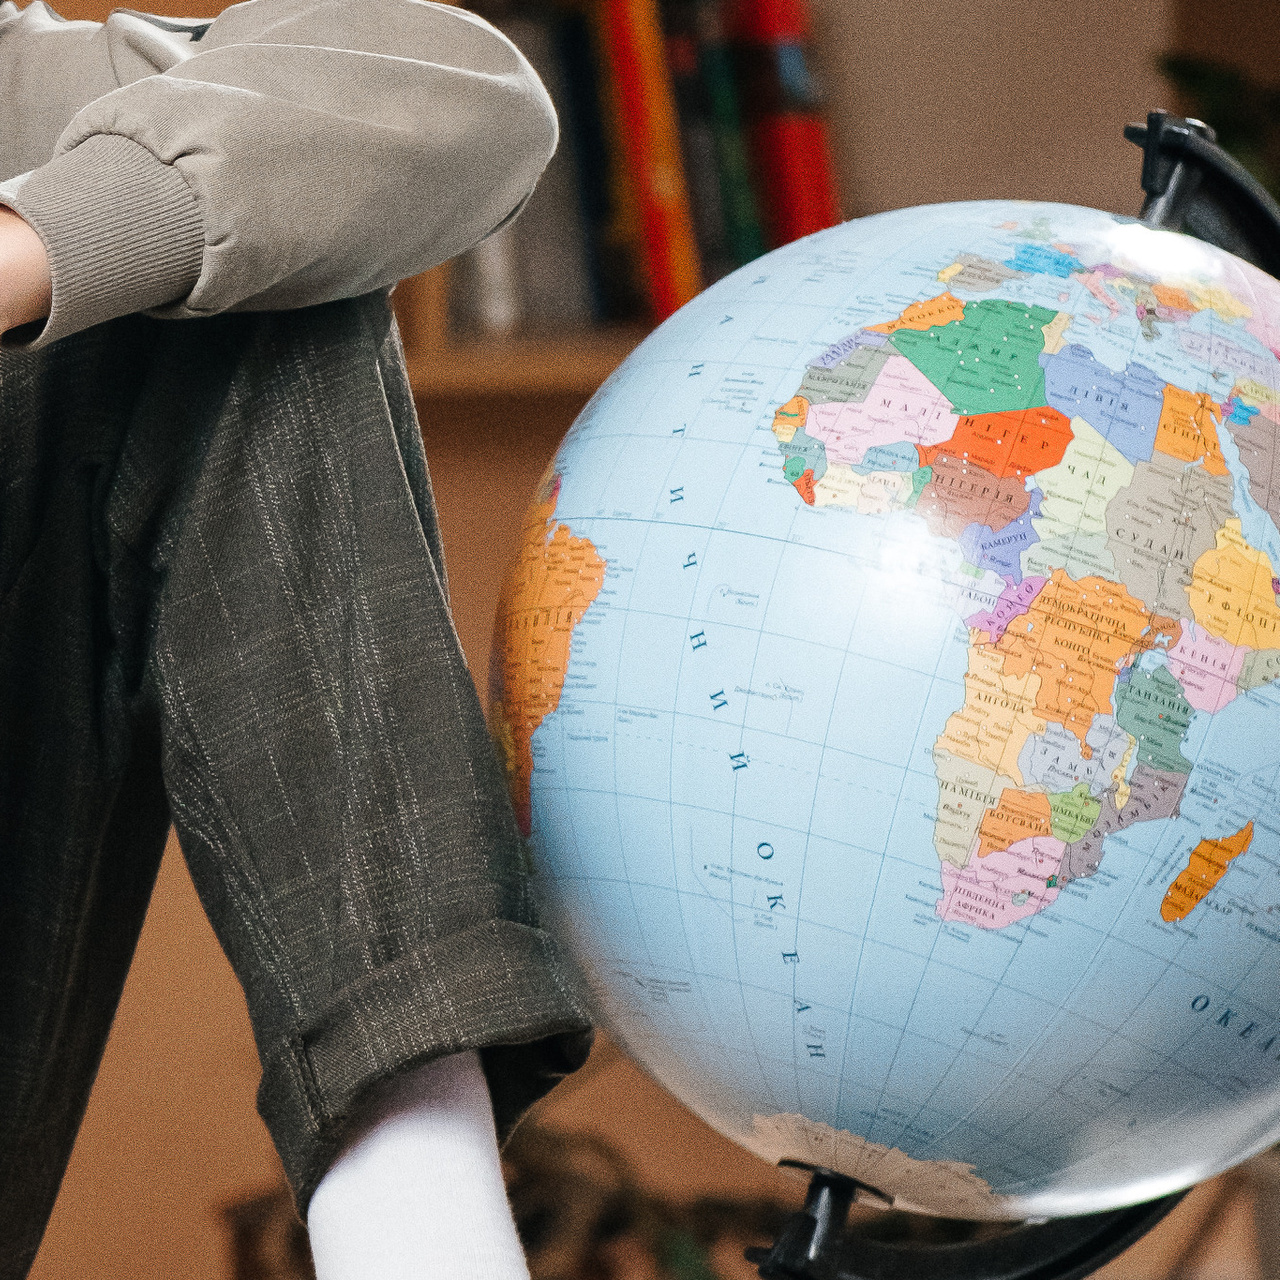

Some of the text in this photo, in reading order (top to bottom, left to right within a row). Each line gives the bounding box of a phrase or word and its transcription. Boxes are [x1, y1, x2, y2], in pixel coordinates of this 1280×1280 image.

[879, 398, 942, 421] МАЛІ
[1069, 384, 1129, 412] ЛІВІЯ
[963, 417, 1051, 451] НІГЕР
[933, 472, 1014, 504] НІГЕРІЯ
[1067, 463, 1107, 487] ЧАД
[1115, 528, 1185, 561] СУДАН
[1179, 645, 1228, 672] КЕНІЯ
[974, 691, 1026, 715] АНГОЛА
[1128, 684, 1190, 716] ТАНЗАНІЯ
[939, 779, 997, 807] НАМІБІЯ
[988, 808, 1051, 837] БОТСВАНА
[953, 898, 997, 921] АФРИКА
[756, 841, 826, 1058] ОКЕАН
